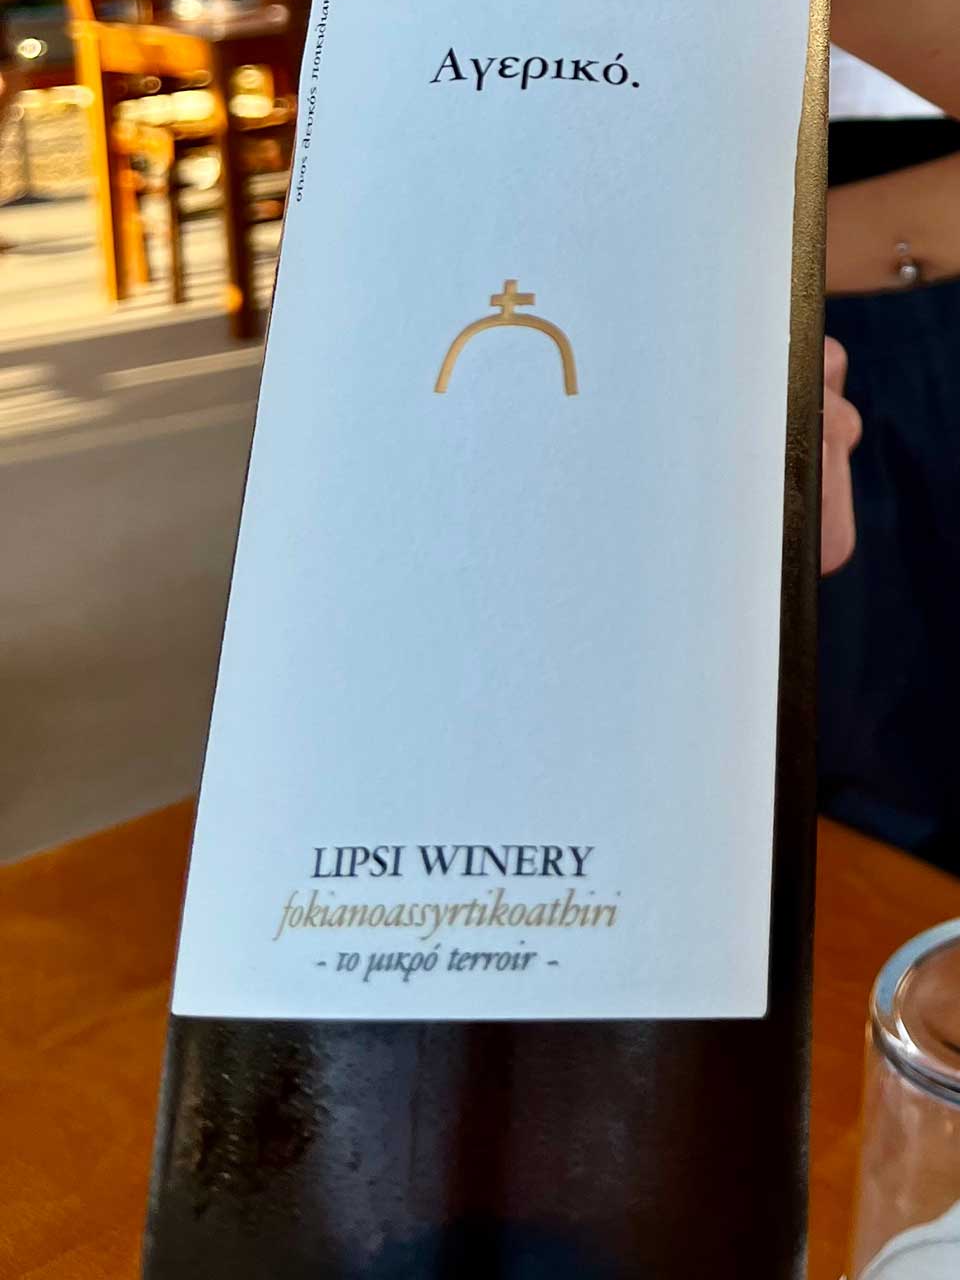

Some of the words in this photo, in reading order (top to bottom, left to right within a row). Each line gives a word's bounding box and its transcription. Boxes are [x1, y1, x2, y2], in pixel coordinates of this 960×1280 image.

[429, 47, 641, 91] Αγερικό.
[302, 87, 317, 149] λευκός
[311, 845, 406, 878] LIPSI
[417, 844, 595, 878] WINERY
[273, 888, 622, 941] fokianoassyrtikoathiri
[363, 943, 441, 983] μικρό
[446, 940, 537, 972] terroir
